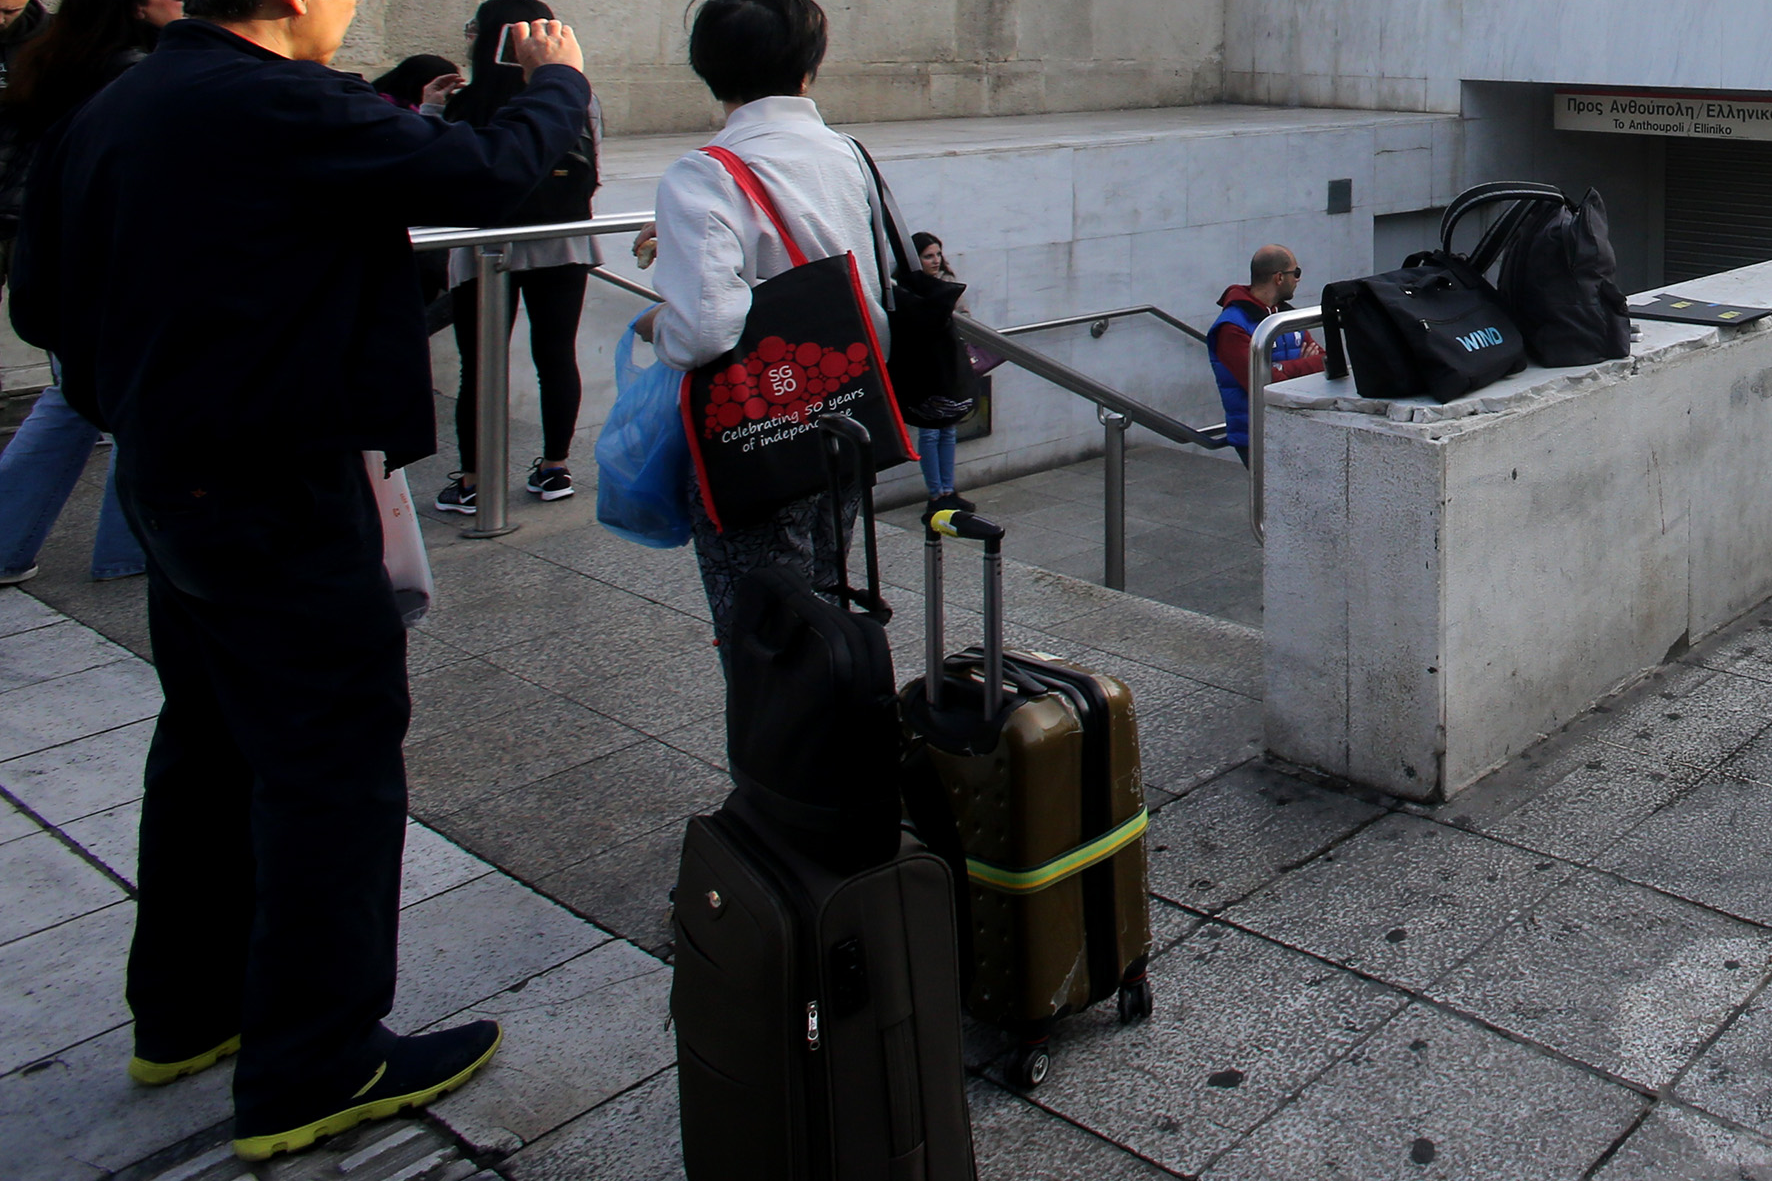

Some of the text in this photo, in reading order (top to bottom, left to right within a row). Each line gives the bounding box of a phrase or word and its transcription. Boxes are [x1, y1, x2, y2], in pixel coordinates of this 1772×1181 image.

[1567, 98, 1603, 114] Προς
[1613, 119, 1624, 129] To
[1457, 326, 1503, 352] WIND
[768, 365, 793, 382] SG
[773, 378, 797, 396] 50
[722, 388, 865, 443] Celebrating 50 years
[742, 437, 755, 452] of
